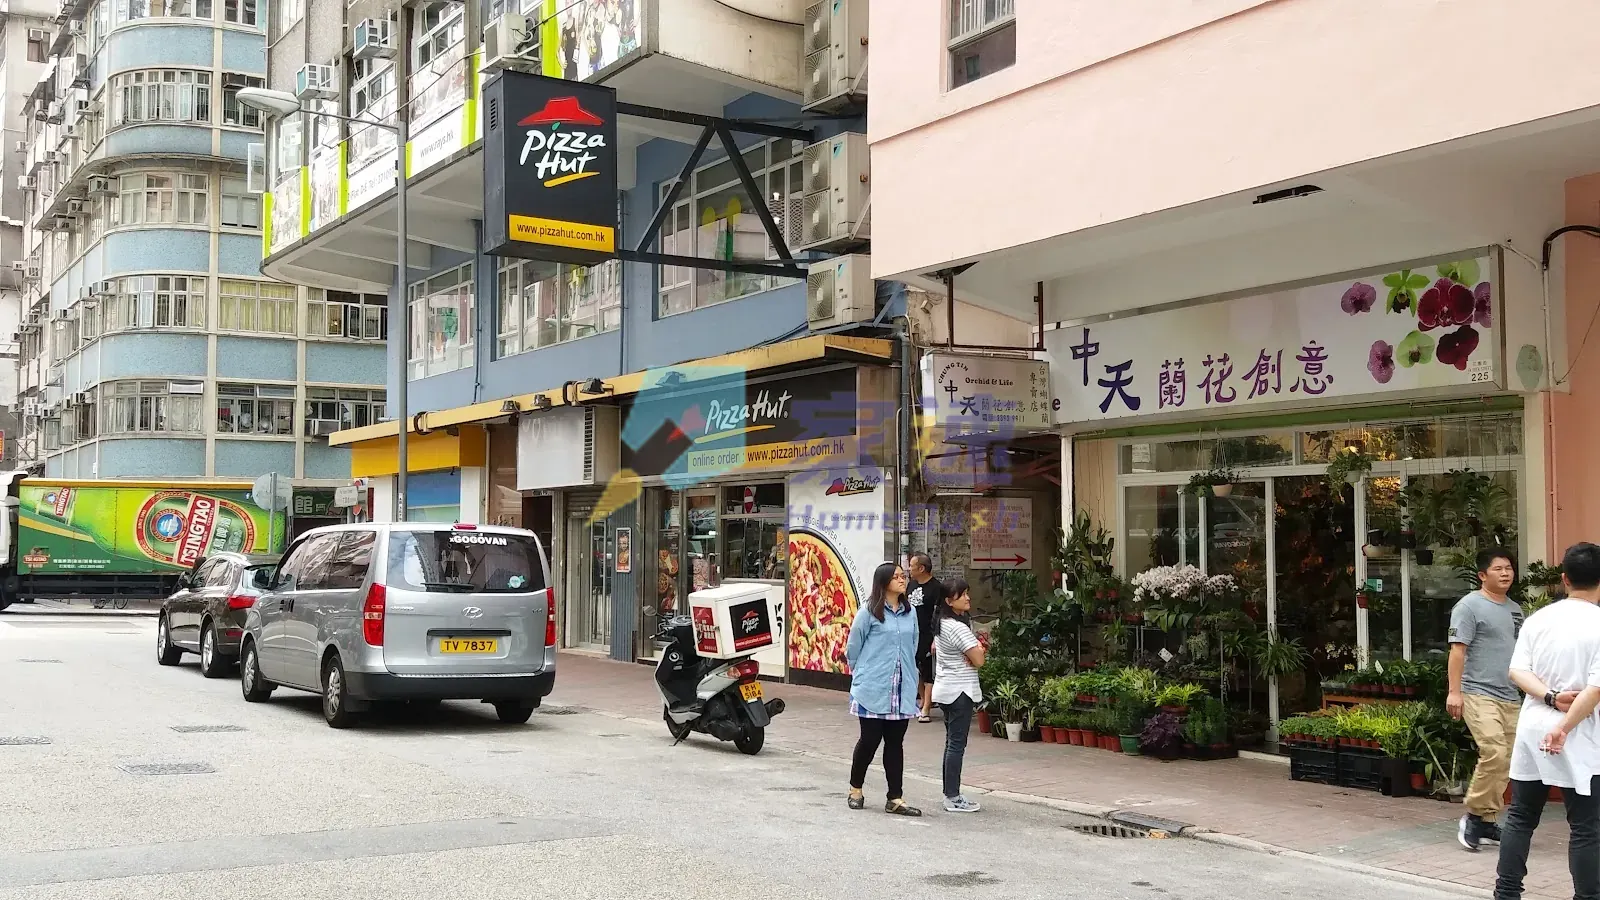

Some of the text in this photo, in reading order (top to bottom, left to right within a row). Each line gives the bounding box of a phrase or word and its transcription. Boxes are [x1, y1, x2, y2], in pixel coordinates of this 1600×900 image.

[519, 126, 606, 165] Pizza
[535, 151, 597, 179] Hut
[517, 223, 605, 242] www.pizzahut.com.hk
[938, 362, 969, 384] CHUNG TIN
[965, 377, 990, 385] Orchid
[1471, 371, 1489, 381] 225
[704, 389, 792, 434] Pizza Hut
[692, 453, 715, 466] online
[717, 451, 739, 465] order
[747, 439, 845, 464] www.pizzahut.com.hk
[843, 476, 863, 491] Pizza
[295, 496, 313, 514] 館
[181, 499, 212, 563] TSINGTAO
[444, 641, 493, 651] TV 7837
